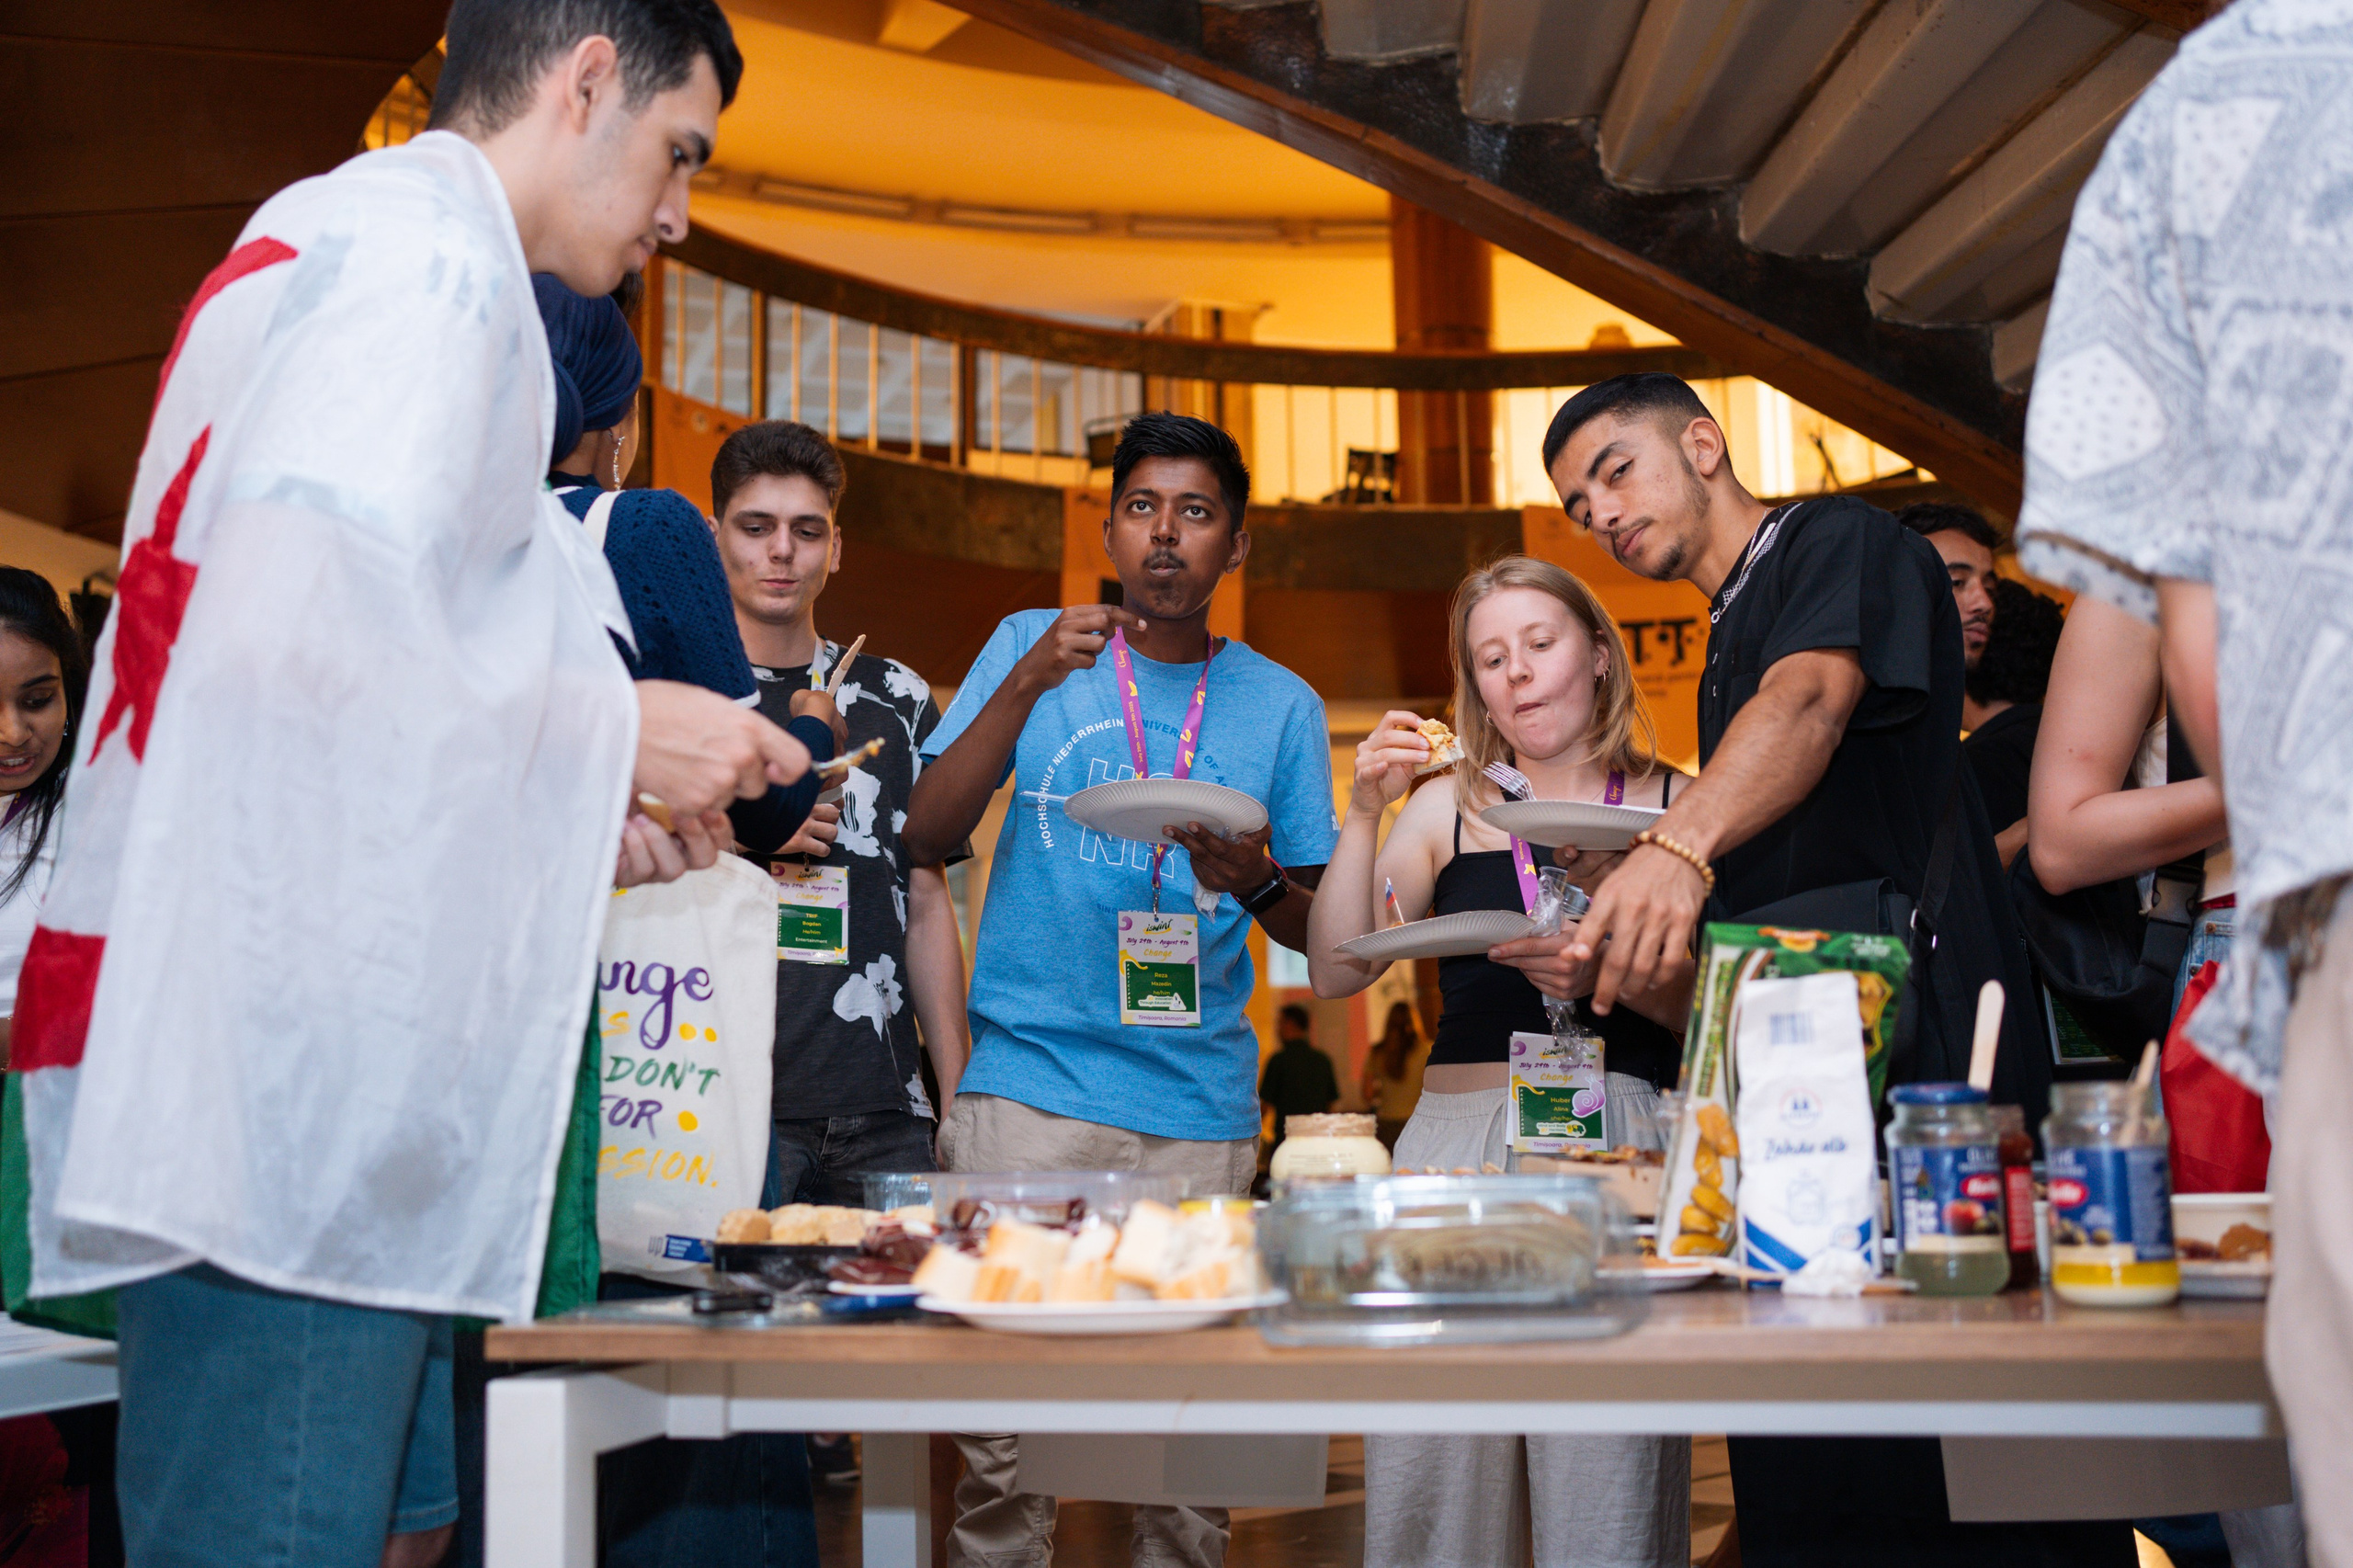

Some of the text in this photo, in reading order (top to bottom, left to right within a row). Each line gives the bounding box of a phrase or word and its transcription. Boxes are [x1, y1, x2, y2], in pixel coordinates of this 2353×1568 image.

[1204, 755, 1219, 771] OF
[1037, 718, 1125, 848] HOCHSCHULE NIEDERRHEIN
[796, 892, 824, 904] Change
[1097, 903, 1122, 915] SINC
[1126, 937, 1138, 946] July
[1159, 939, 1178, 948] August
[1143, 949, 1173, 961] Change
[1519, 1062, 1532, 1071] July
[604, 1055, 721, 1096] DON'T
[1540, 1073, 1574, 1086] Change
